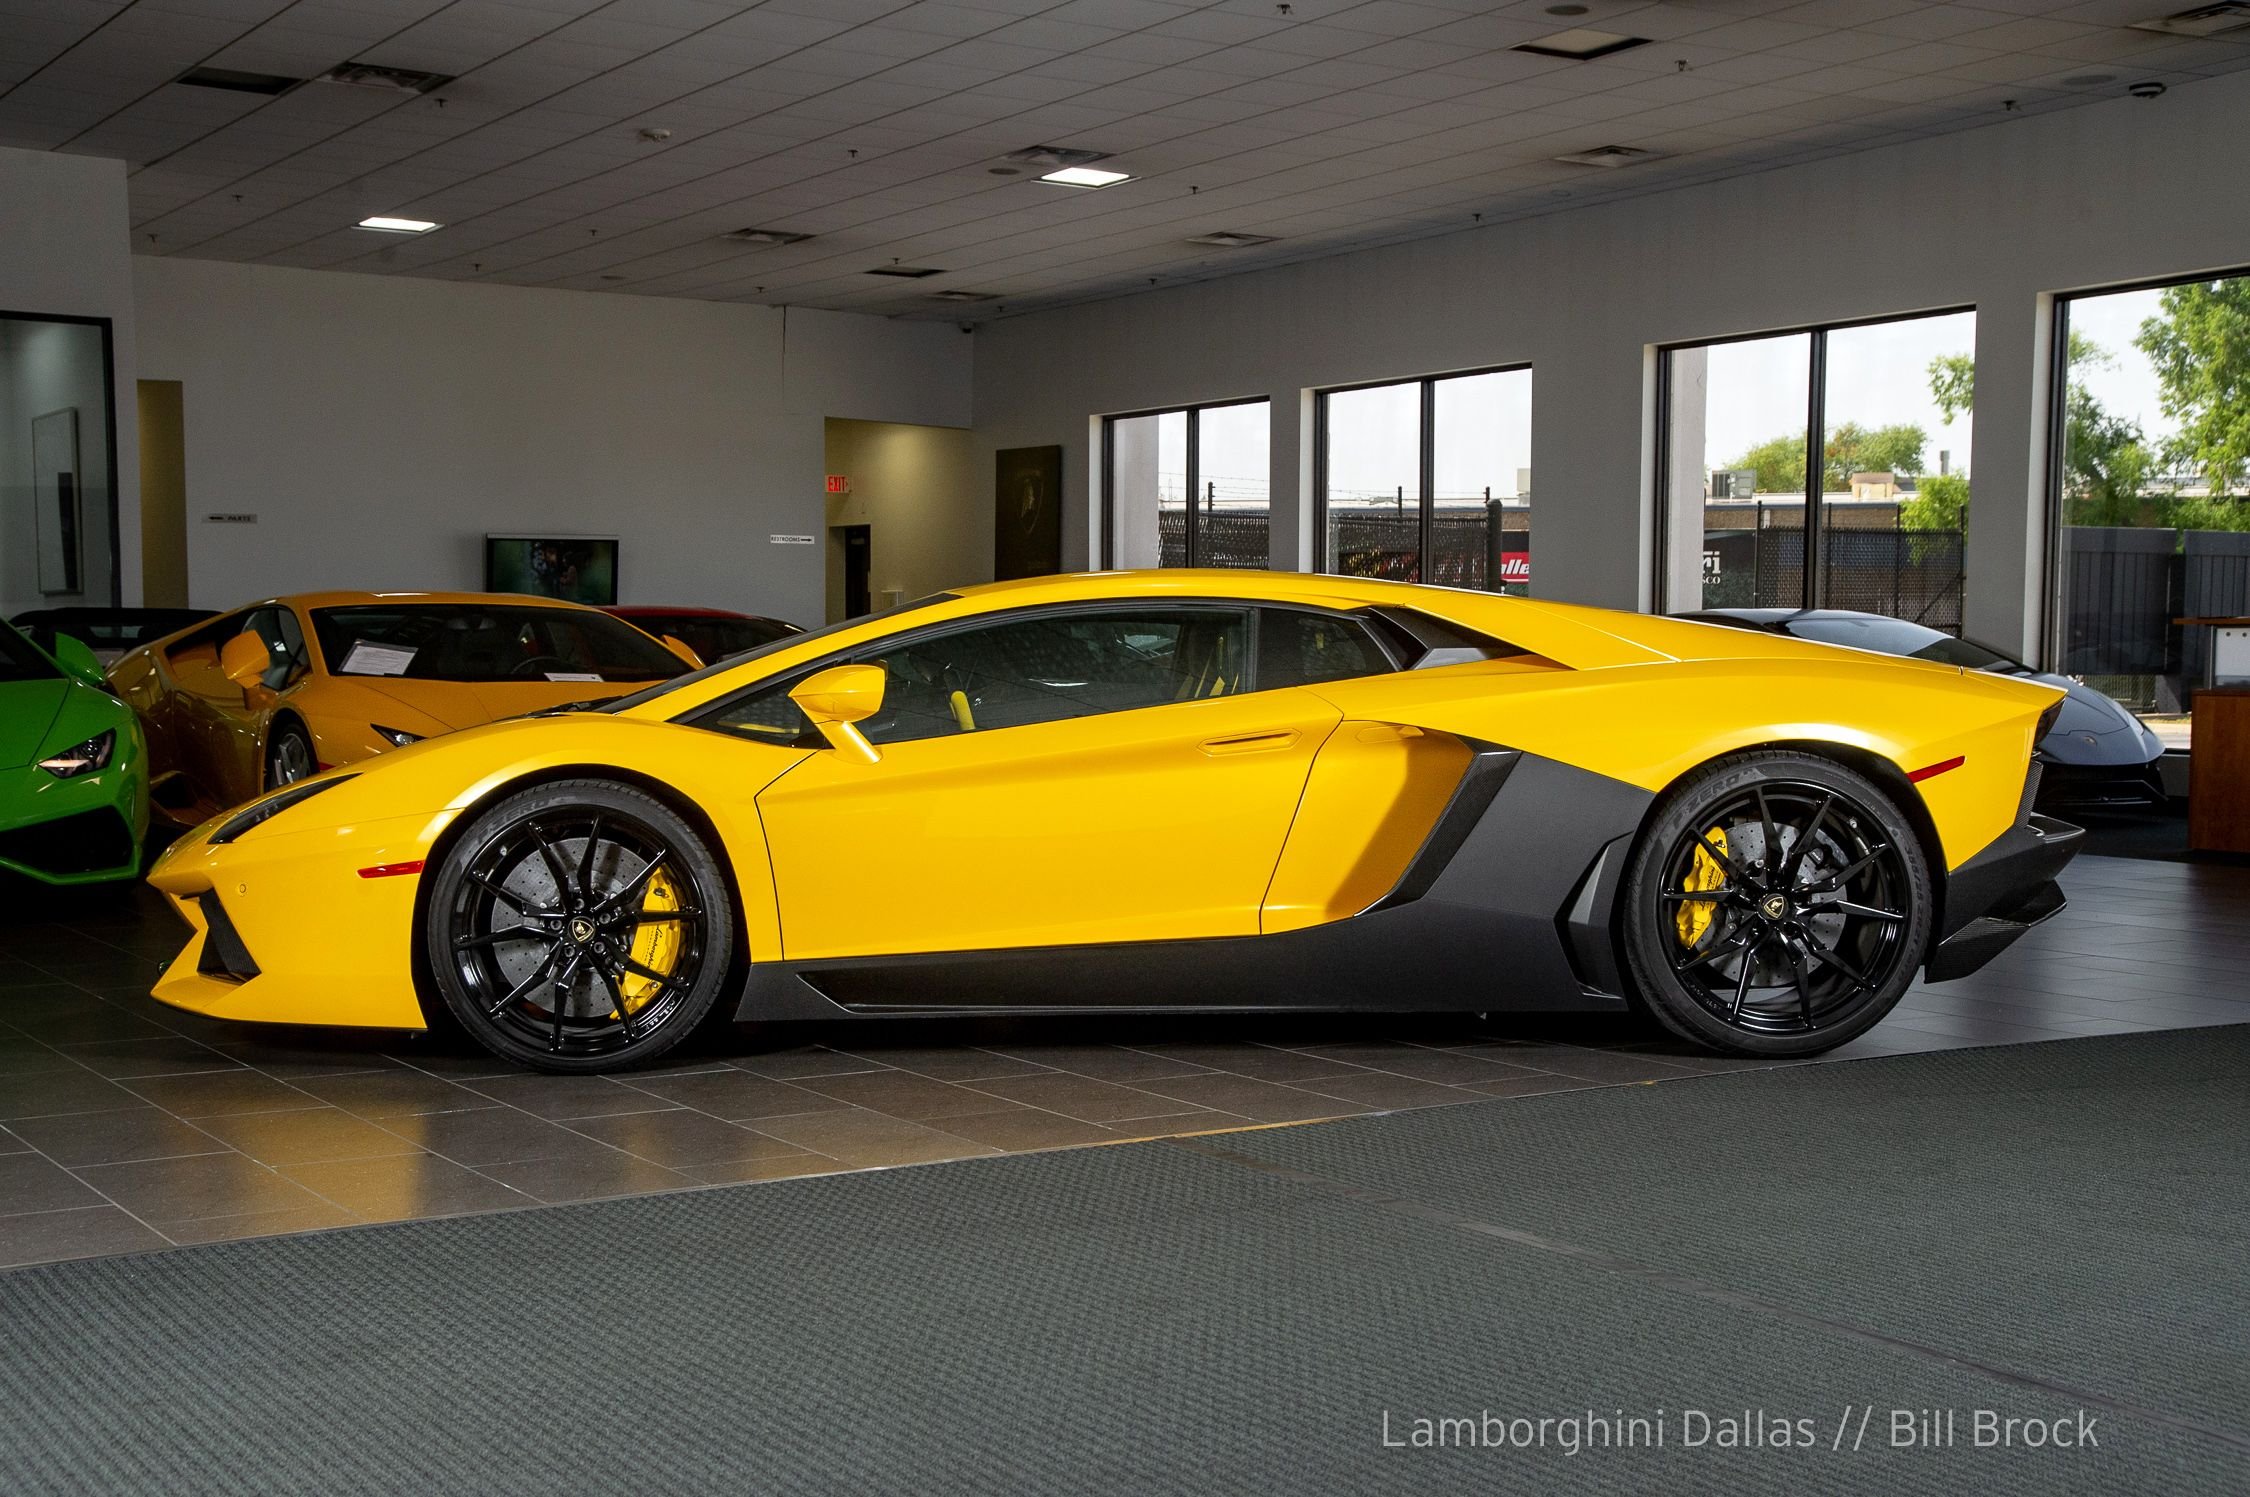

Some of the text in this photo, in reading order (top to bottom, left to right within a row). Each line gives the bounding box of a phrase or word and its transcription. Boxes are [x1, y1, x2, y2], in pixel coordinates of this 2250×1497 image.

[828, 475, 845, 492] EXIT
[1688, 773, 1740, 814] ZERO
[648, 925, 663, 968] Lamborghin
